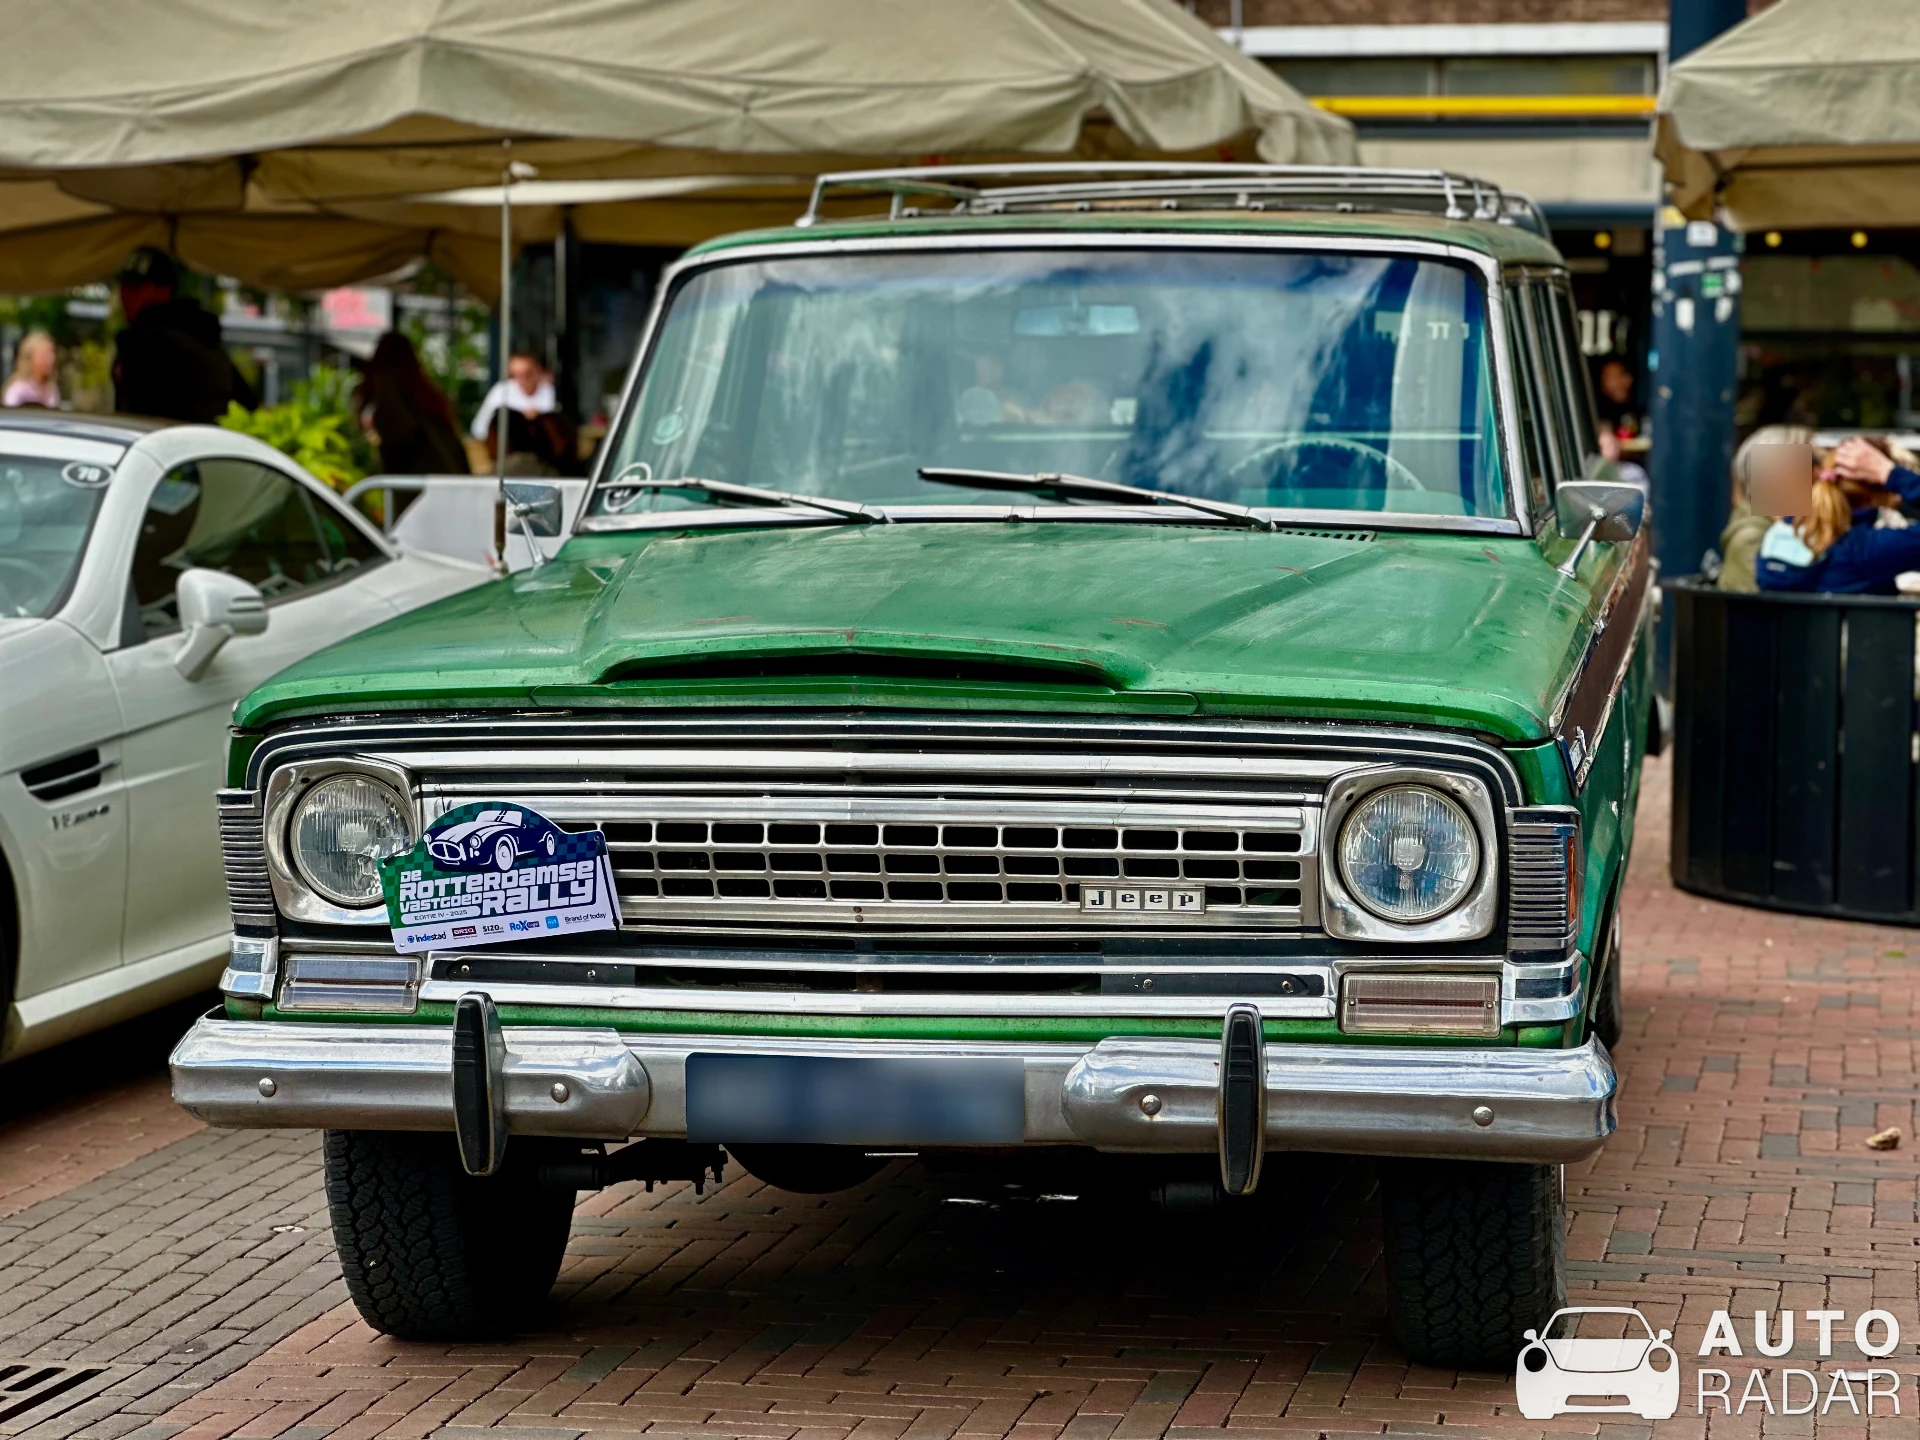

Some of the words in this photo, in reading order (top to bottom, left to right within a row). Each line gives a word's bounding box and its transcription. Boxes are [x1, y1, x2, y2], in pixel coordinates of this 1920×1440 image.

[399, 859, 595, 901] ROTTERDAMSE
[400, 869, 422, 883] DE
[399, 892, 483, 913] VASTGOED
[482, 878, 594, 916] RALLY
[1090, 890, 1194, 907] Jeep
[414, 913, 438, 921] EDITIE
[564, 914, 582, 923] Brand
[582, 913, 589, 921] of
[589, 912, 607, 920] today
[415, 931, 447, 943] indestad
